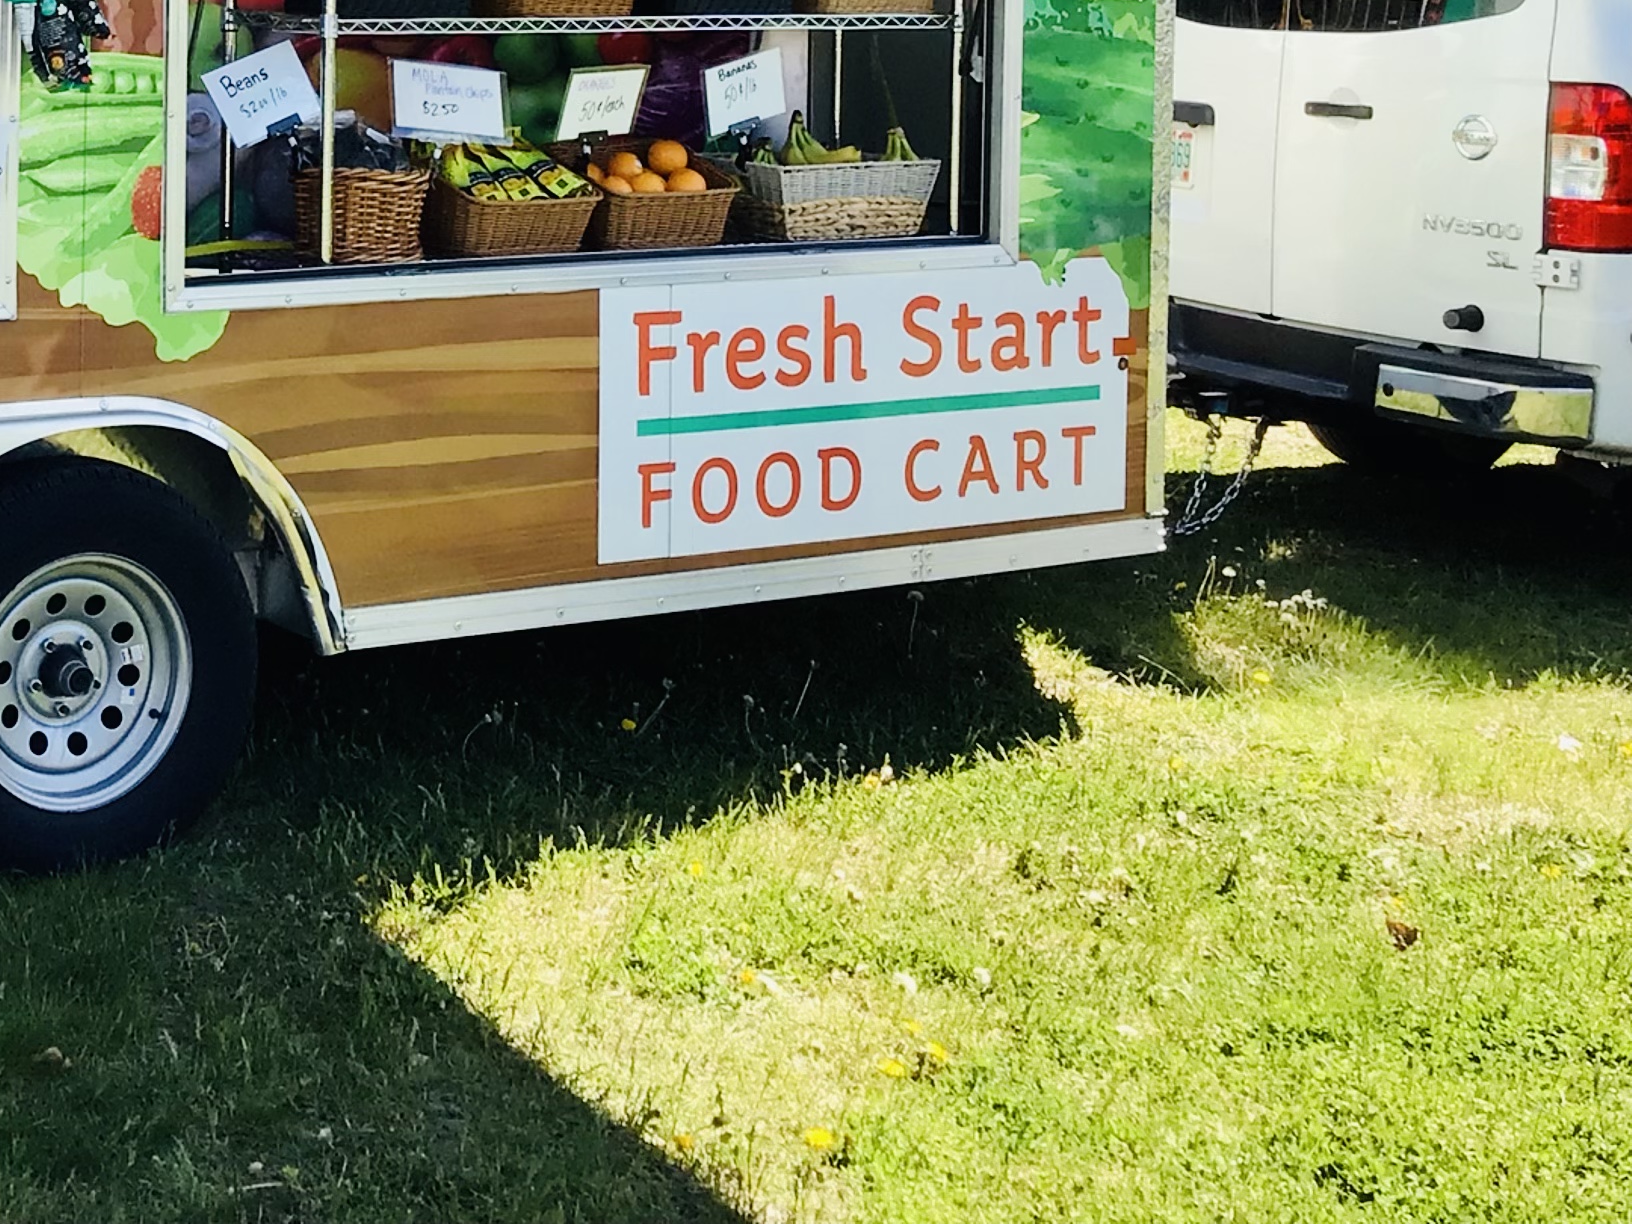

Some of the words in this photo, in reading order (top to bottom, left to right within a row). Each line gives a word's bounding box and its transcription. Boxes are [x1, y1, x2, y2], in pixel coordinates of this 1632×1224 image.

[219, 67, 270, 98] Beans
[411, 68, 449, 87] MOLA
[718, 60, 757, 82] Bananas
[1422, 213, 1523, 241] NV3500
[632, 295, 867, 396] Fresh
[900, 295, 1103, 378] Start
[637, 445, 862, 529] FOOD
[904, 425, 1096, 502] CART
